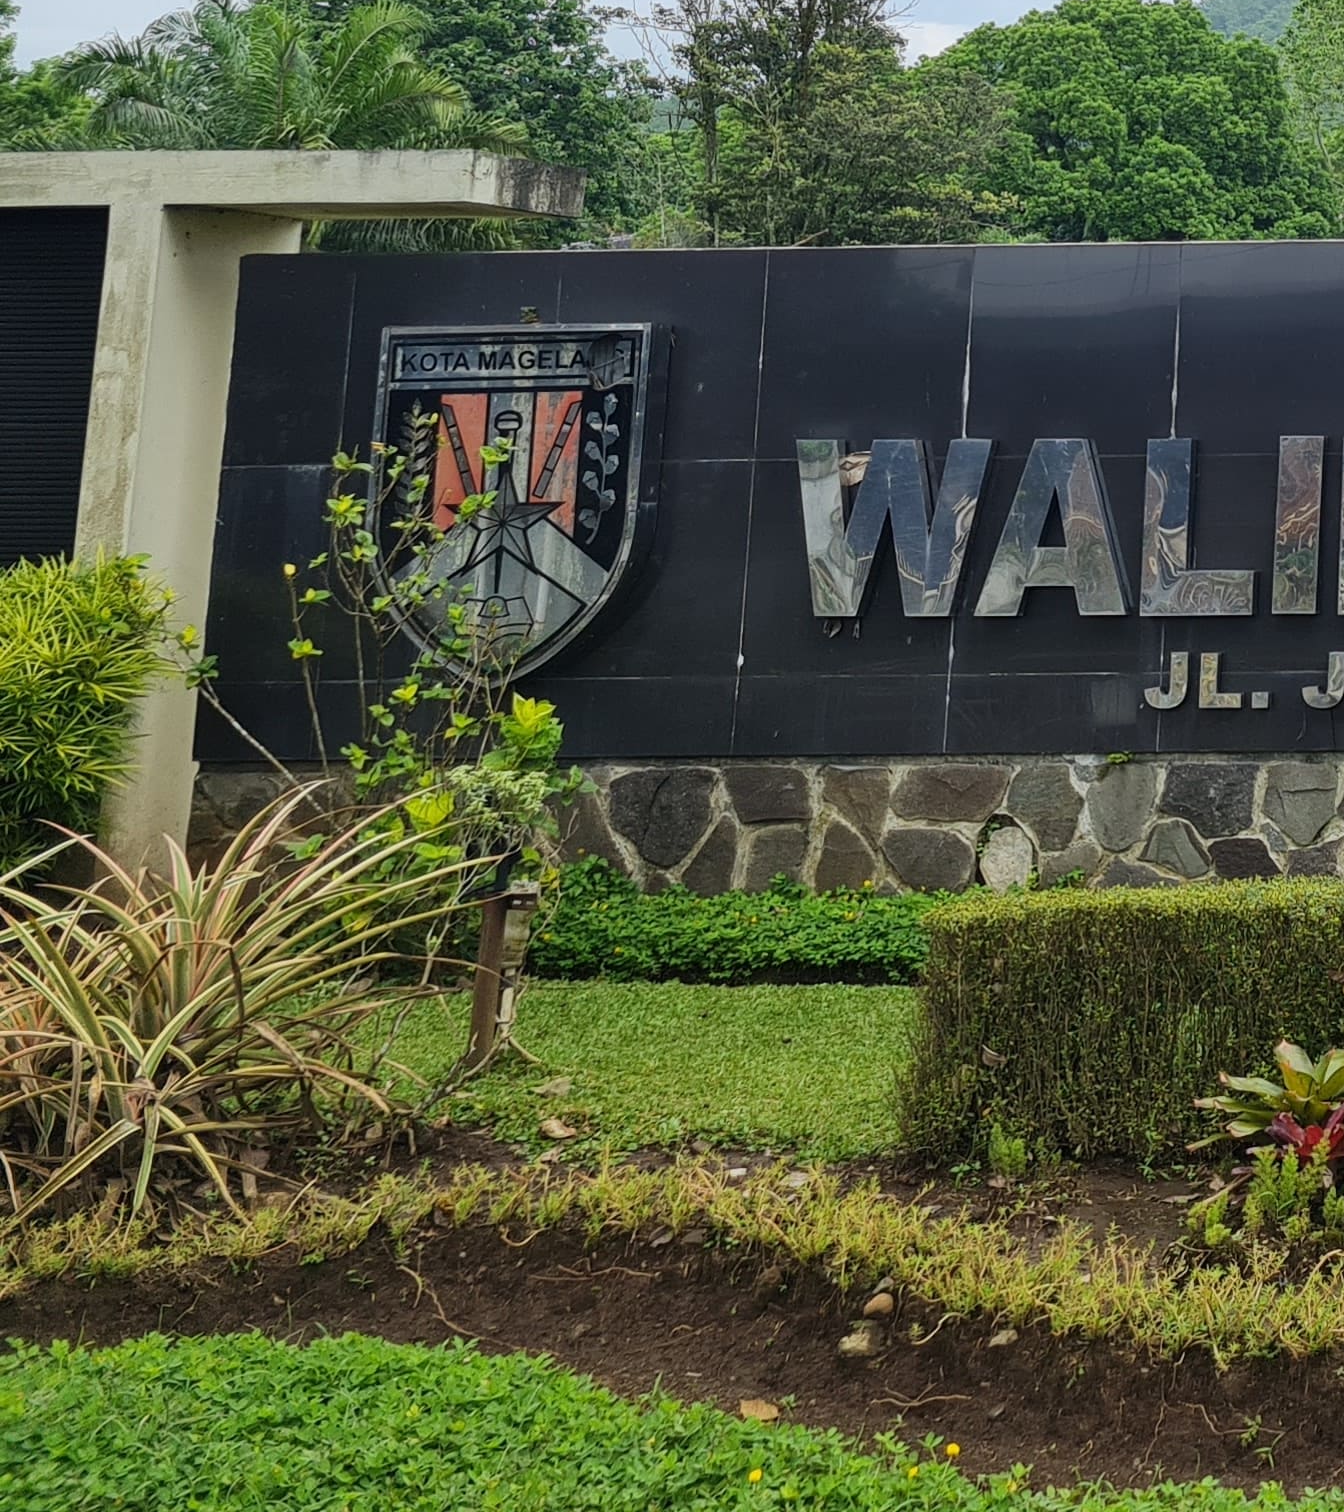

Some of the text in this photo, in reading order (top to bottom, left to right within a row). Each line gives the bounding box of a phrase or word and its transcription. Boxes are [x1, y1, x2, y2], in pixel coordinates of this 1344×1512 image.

[402, 348, 624, 372] KOTA MAGELA
[1143, 651, 1270, 709] JL.
